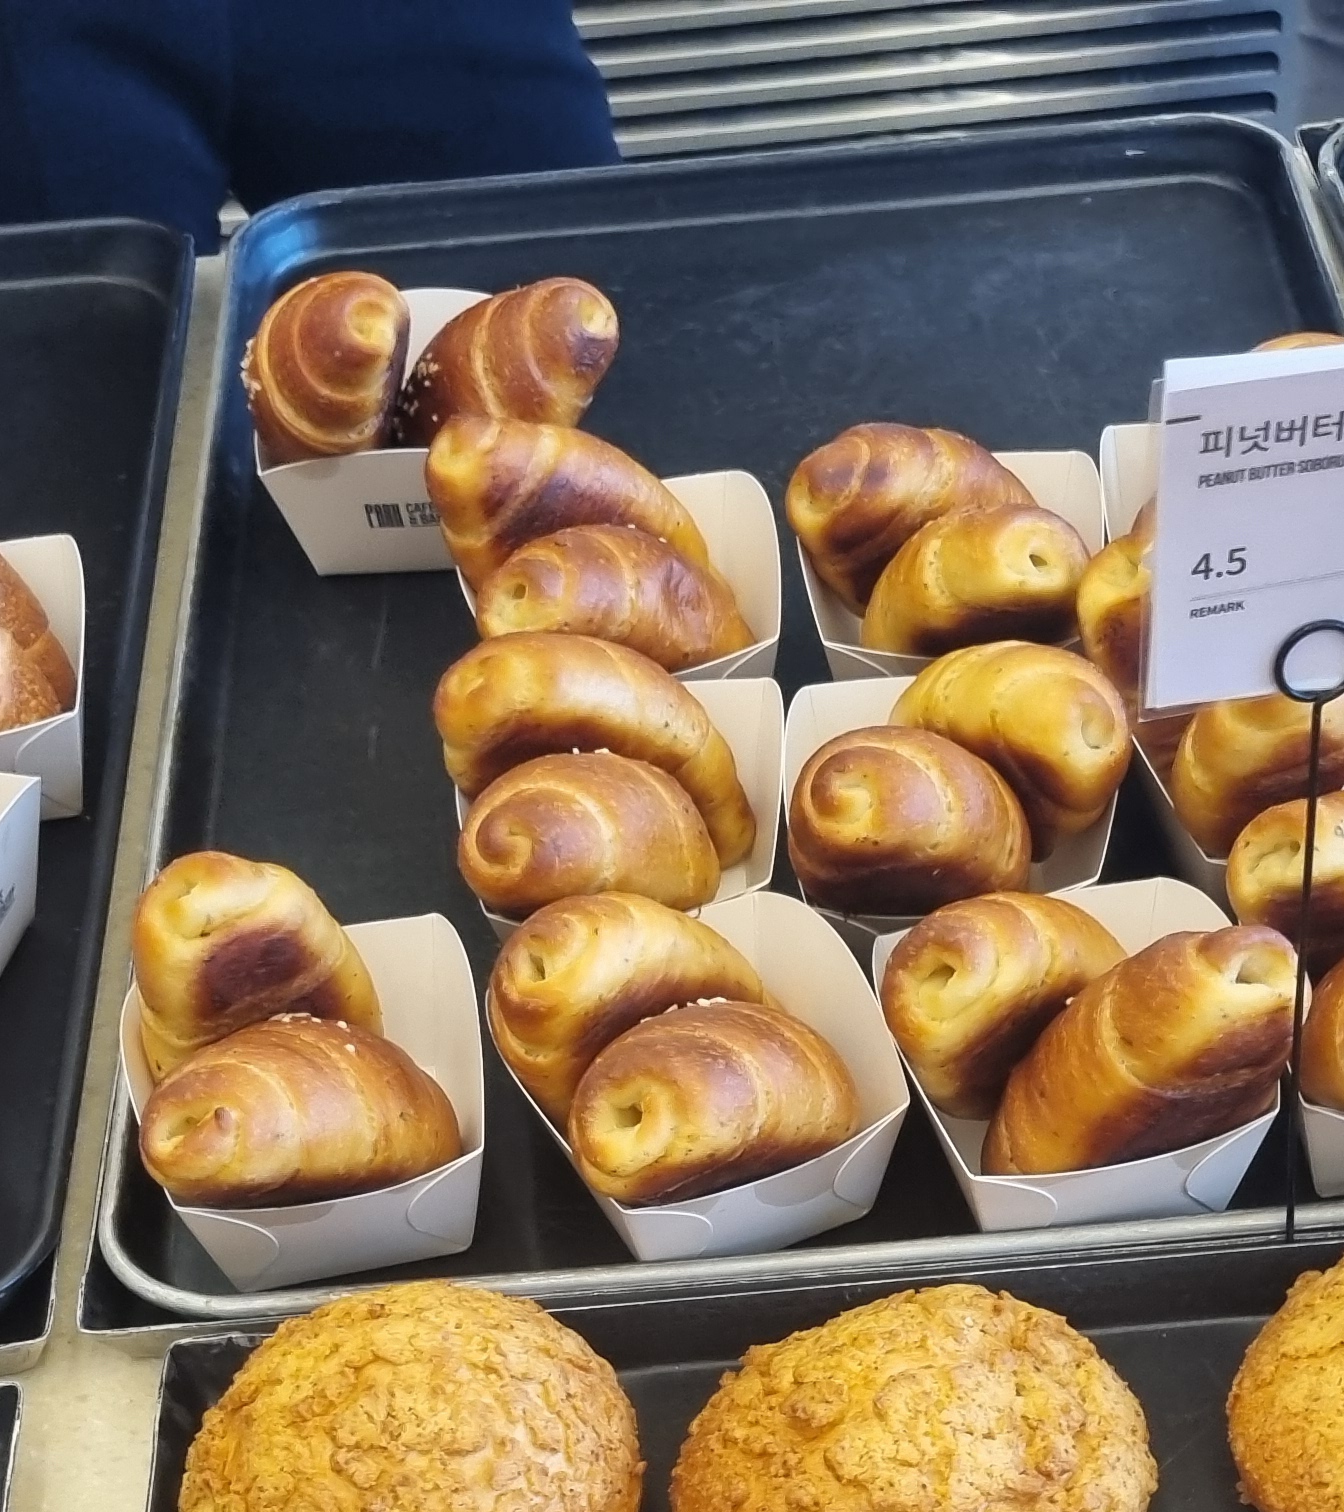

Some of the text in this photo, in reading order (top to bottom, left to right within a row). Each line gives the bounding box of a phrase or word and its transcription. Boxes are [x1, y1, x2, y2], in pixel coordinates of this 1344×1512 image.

[1197, 469, 1247, 489] PEANUT
[1247, 461, 1295, 482] BUTTER
[1190, 546, 1248, 581] 4.5
[1189, 600, 1246, 620] REMARK
